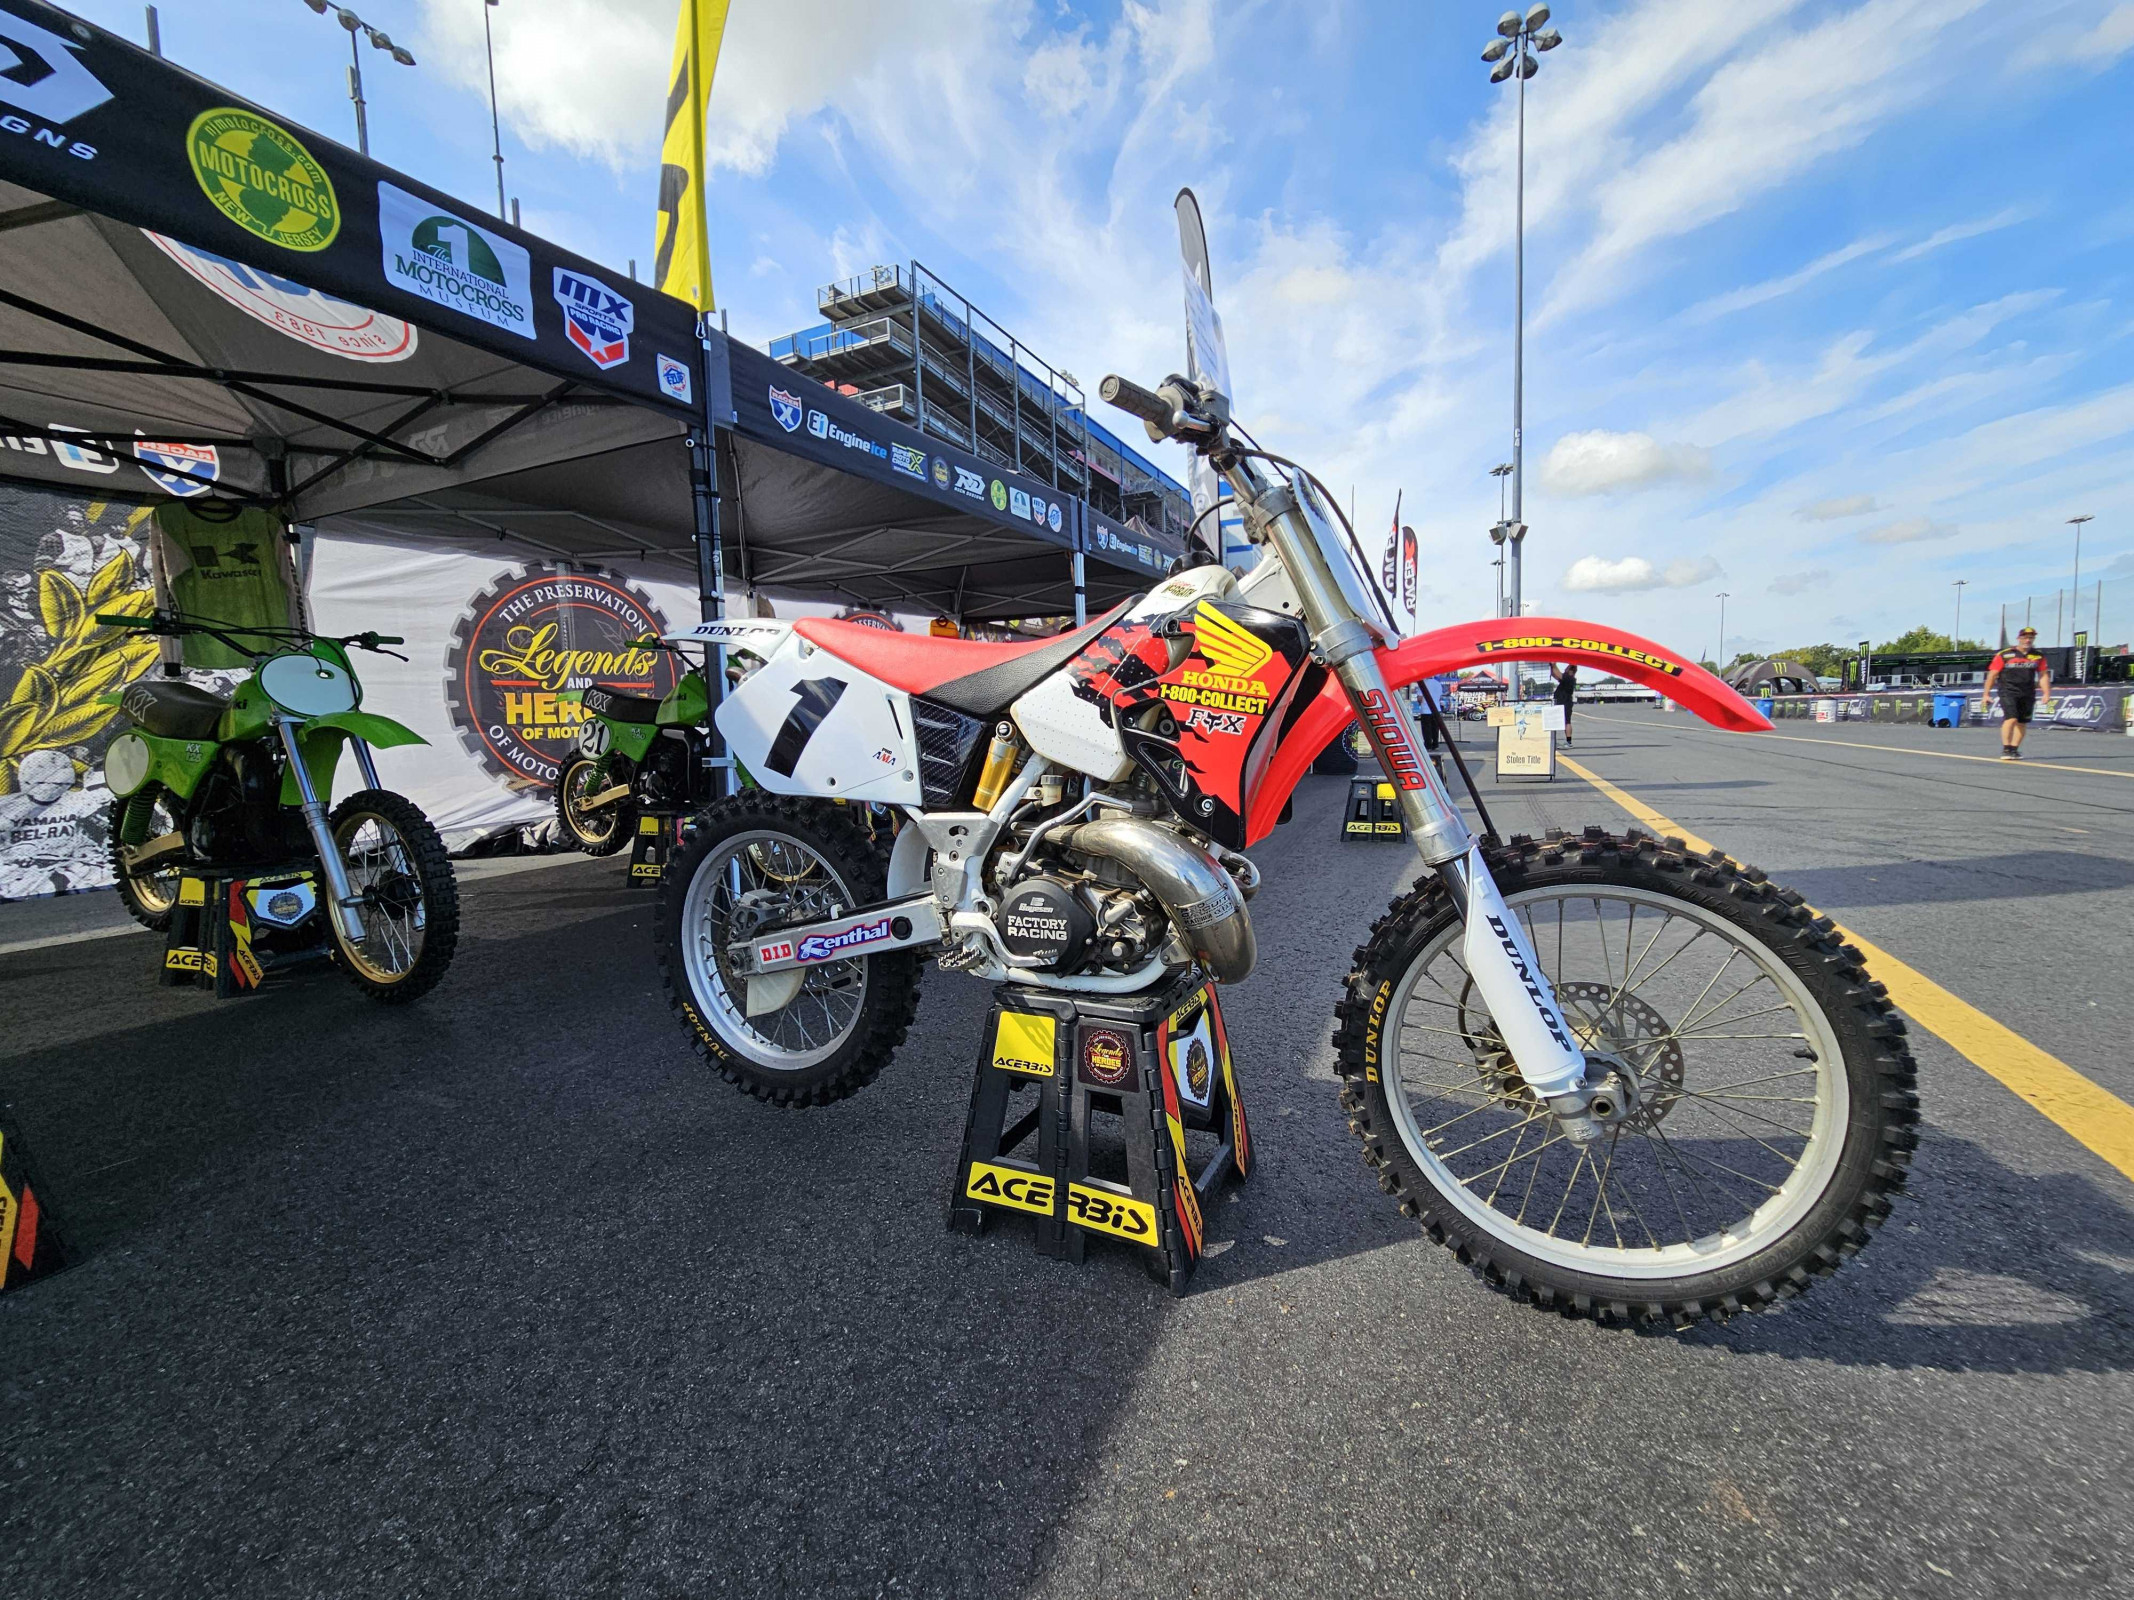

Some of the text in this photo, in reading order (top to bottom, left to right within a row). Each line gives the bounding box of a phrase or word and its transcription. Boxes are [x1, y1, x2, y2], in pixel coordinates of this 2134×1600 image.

[205, 117, 323, 183] njmotocross.com
[199, 140, 332, 219] MOTOCROSS
[214, 190, 325, 248] NEW JERSEY
[394, 253, 525, 322] MOTOCROSS
[412, 250, 509, 300] INTERNATIONAL
[418, 282, 510, 328] MUSEUM
[559, 273, 632, 324] MX
[574, 302, 616, 324] SPORTS
[569, 308, 621, 336] PRO RACING
[778, 403, 796, 426] X
[498, 584, 648, 633] THE PRESERVATION
[479, 623, 659, 691] Legends
[1479, 637, 1680, 675] 1-800-COLLECT
[567, 679, 593, 689] AND
[584, 689, 613, 712] KX
[1160, 684, 1268, 716] 1-800-COLLECT
[1181, 671, 1270, 698] HONDA
[122, 686, 158, 723] KX
[488, 725, 513, 748] OF
[522, 727, 544, 740] OF
[580, 718, 605, 756] 21
[764, 677, 849, 778] 1
[1356, 688, 1427, 791] SHOWA
[186, 743, 201, 753] KX
[882, 747, 893, 756] PRO
[1506, 755, 1542, 765] Stolen Title
[10, 813, 77, 828] YAMAHA
[799, 920, 888, 959] Renthal
[1007, 915, 1068, 930] FACTORY
[1007, 926, 1068, 941] RACING
[1485, 914, 1573, 1053] DUNLOP
[682, 1002, 730, 1060] DUNLOP
[1090, 1042, 1124, 1057] Legends
[1365, 979, 1392, 1085] DUNLOP
[1091, 1055, 1122, 1068] HEROES
